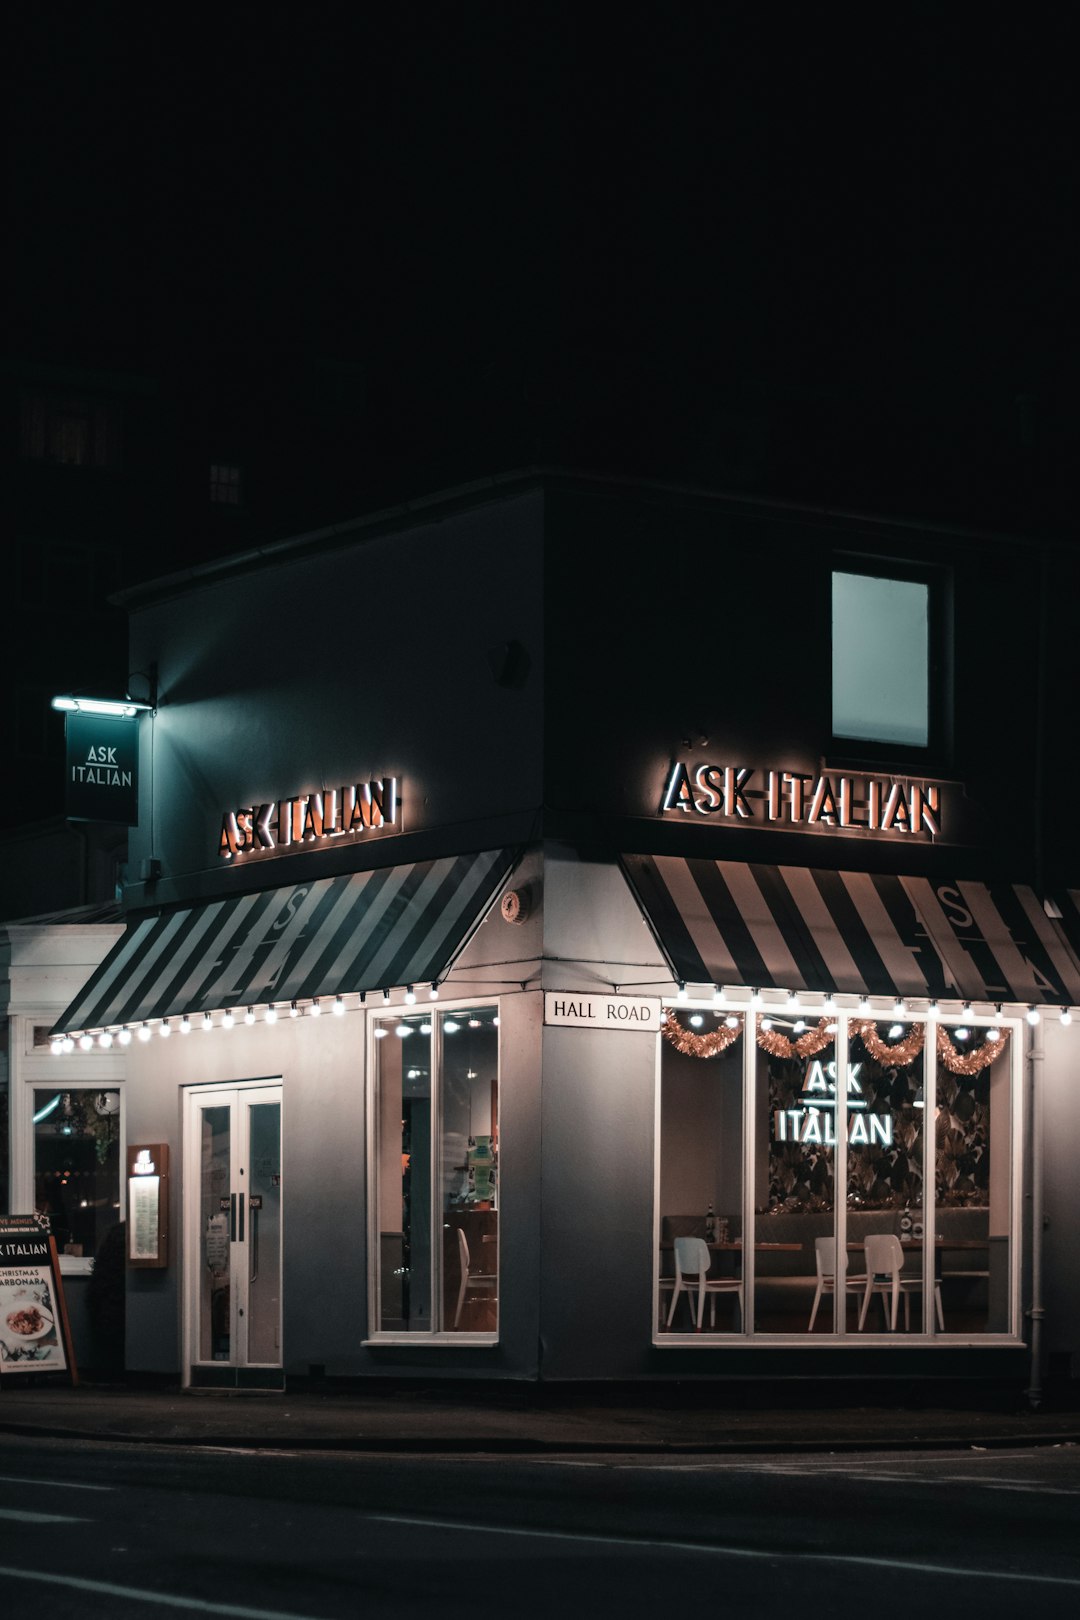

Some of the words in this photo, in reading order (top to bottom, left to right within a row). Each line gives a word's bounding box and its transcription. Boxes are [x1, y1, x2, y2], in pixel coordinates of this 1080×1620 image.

[87, 745, 117, 763] ASK
[72, 766, 132, 787] ITALIAN
[662, 762, 754, 818] ASK
[768, 770, 941, 835] ITALIAN
[218, 801, 275, 858] ASK
[278, 777, 396, 846] ITALIAN
[554, 1000, 596, 1018] HALL
[607, 1004, 651, 1021] ROAD
[775, 1108, 892, 1145] ITALAN
[6, 1243, 48, 1256] ITALIAN
